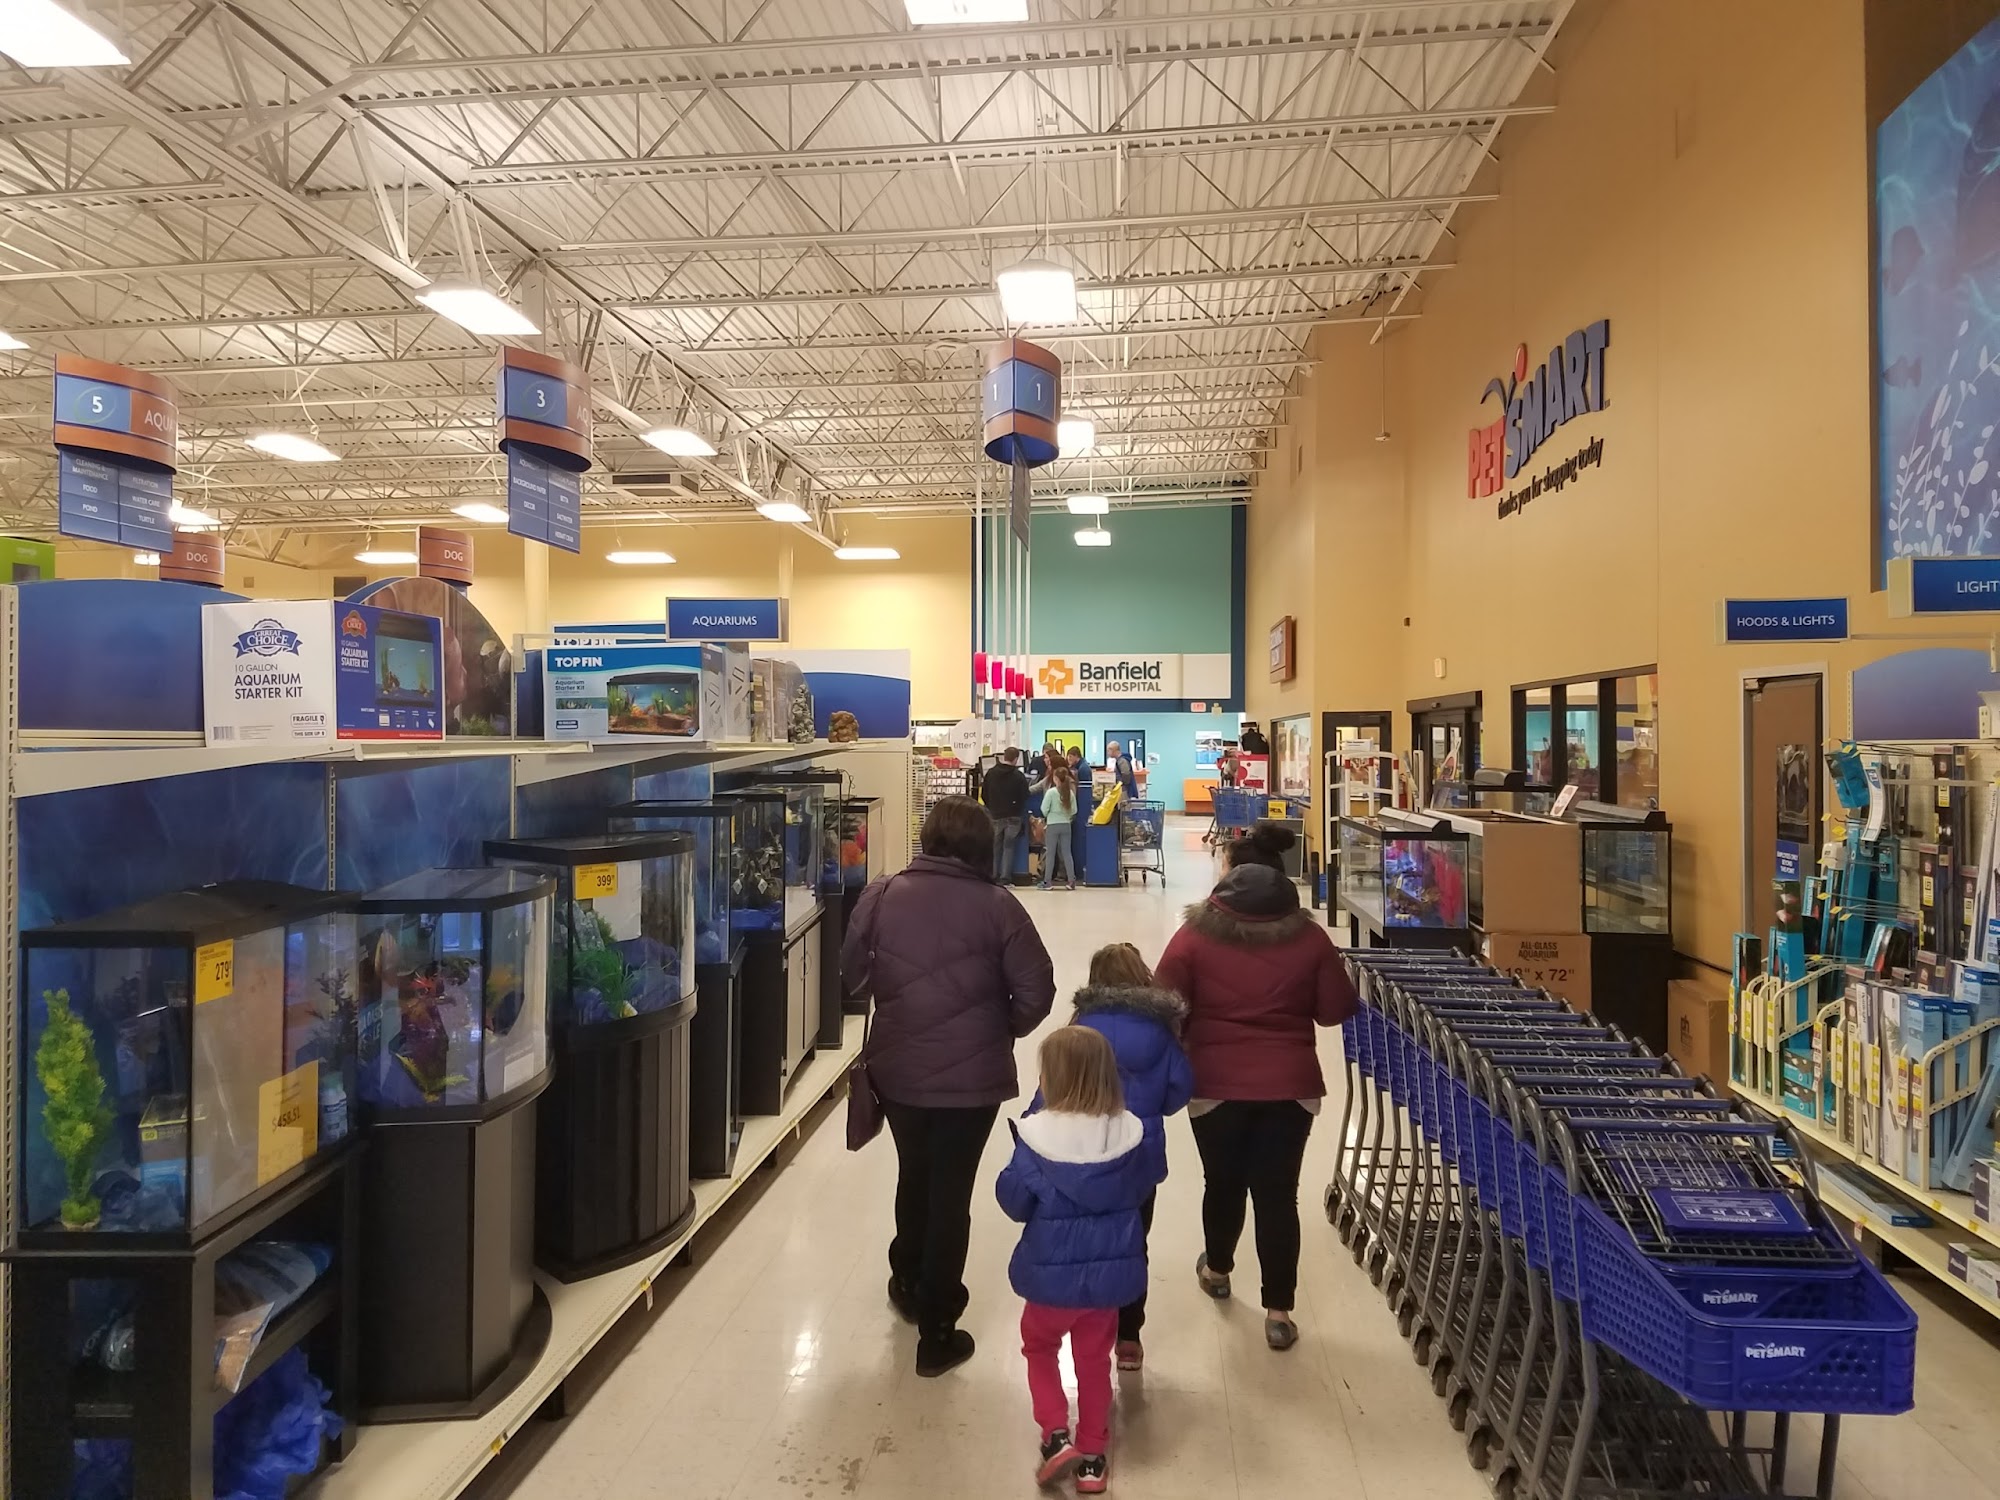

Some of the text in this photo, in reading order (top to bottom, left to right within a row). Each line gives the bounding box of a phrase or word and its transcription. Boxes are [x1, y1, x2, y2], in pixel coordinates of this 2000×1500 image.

[92, 396, 103, 413] 5
[536, 389, 546, 408] 3
[1531, 475, 1543, 500] for
[1543, 466, 1578, 493] shopping
[1578, 436, 1604, 468] today
[82, 484, 98, 494] FOOD
[132, 495, 160, 508] WATER CARE
[82, 504, 98, 513] POND
[138, 514, 155, 524] TURTLE
[186, 551, 208, 564] DOG
[444, 549, 463, 562] DOG
[692, 616, 758, 627] AQUARIUMS
[1737, 614, 1836, 627] HOODS & LIGHTS
[246, 635, 289, 647] CHOICE
[341, 647, 369, 659] AQUARIUM
[235, 663, 278, 673] 10 GALLON
[341, 657, 369, 669] STARTER KIT
[1079, 661, 1161, 680] Banfield
[234, 673, 301, 687] AQUARIUM
[1079, 681, 1162, 692] PET HOSPITAL
[234, 686, 303, 700] STARTER KIT
[963, 731, 977, 740] got
[953, 741, 977, 749] litter?
[1136, 739, 1143, 748] 2
[1520, 941, 1558, 950] ALL-GLASS
[1518, 949, 1559, 959] AQUARIUM
[1535, 971, 1543, 981] x
[1548, 968, 1575, 982] 72"
[1703, 1289, 1758, 1304] PETSMART
[1745, 1343, 1806, 1358] PETSMART
